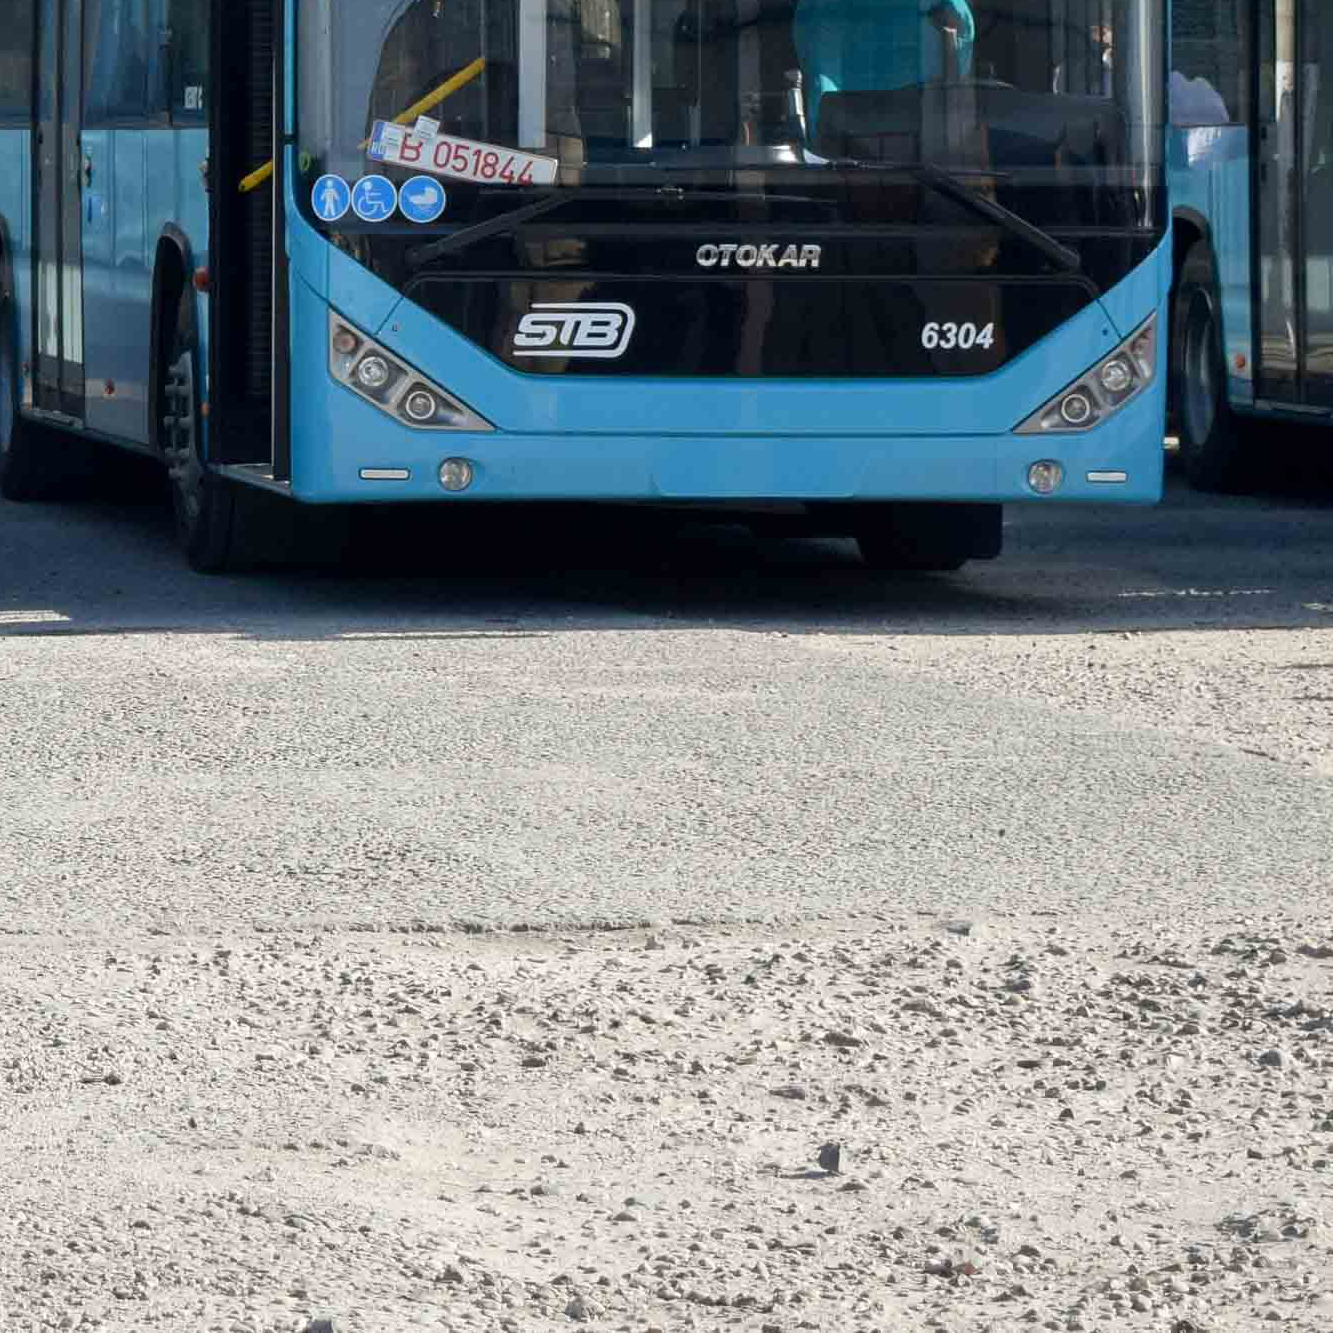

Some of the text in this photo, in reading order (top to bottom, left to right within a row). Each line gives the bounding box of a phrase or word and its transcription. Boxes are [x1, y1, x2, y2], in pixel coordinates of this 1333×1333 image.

[399, 136, 423, 162] B
[433, 141, 535, 186] 051844
[695, 243, 822, 268] OTOKAR
[512, 310, 624, 349] STB
[920, 321, 995, 350] 6304
